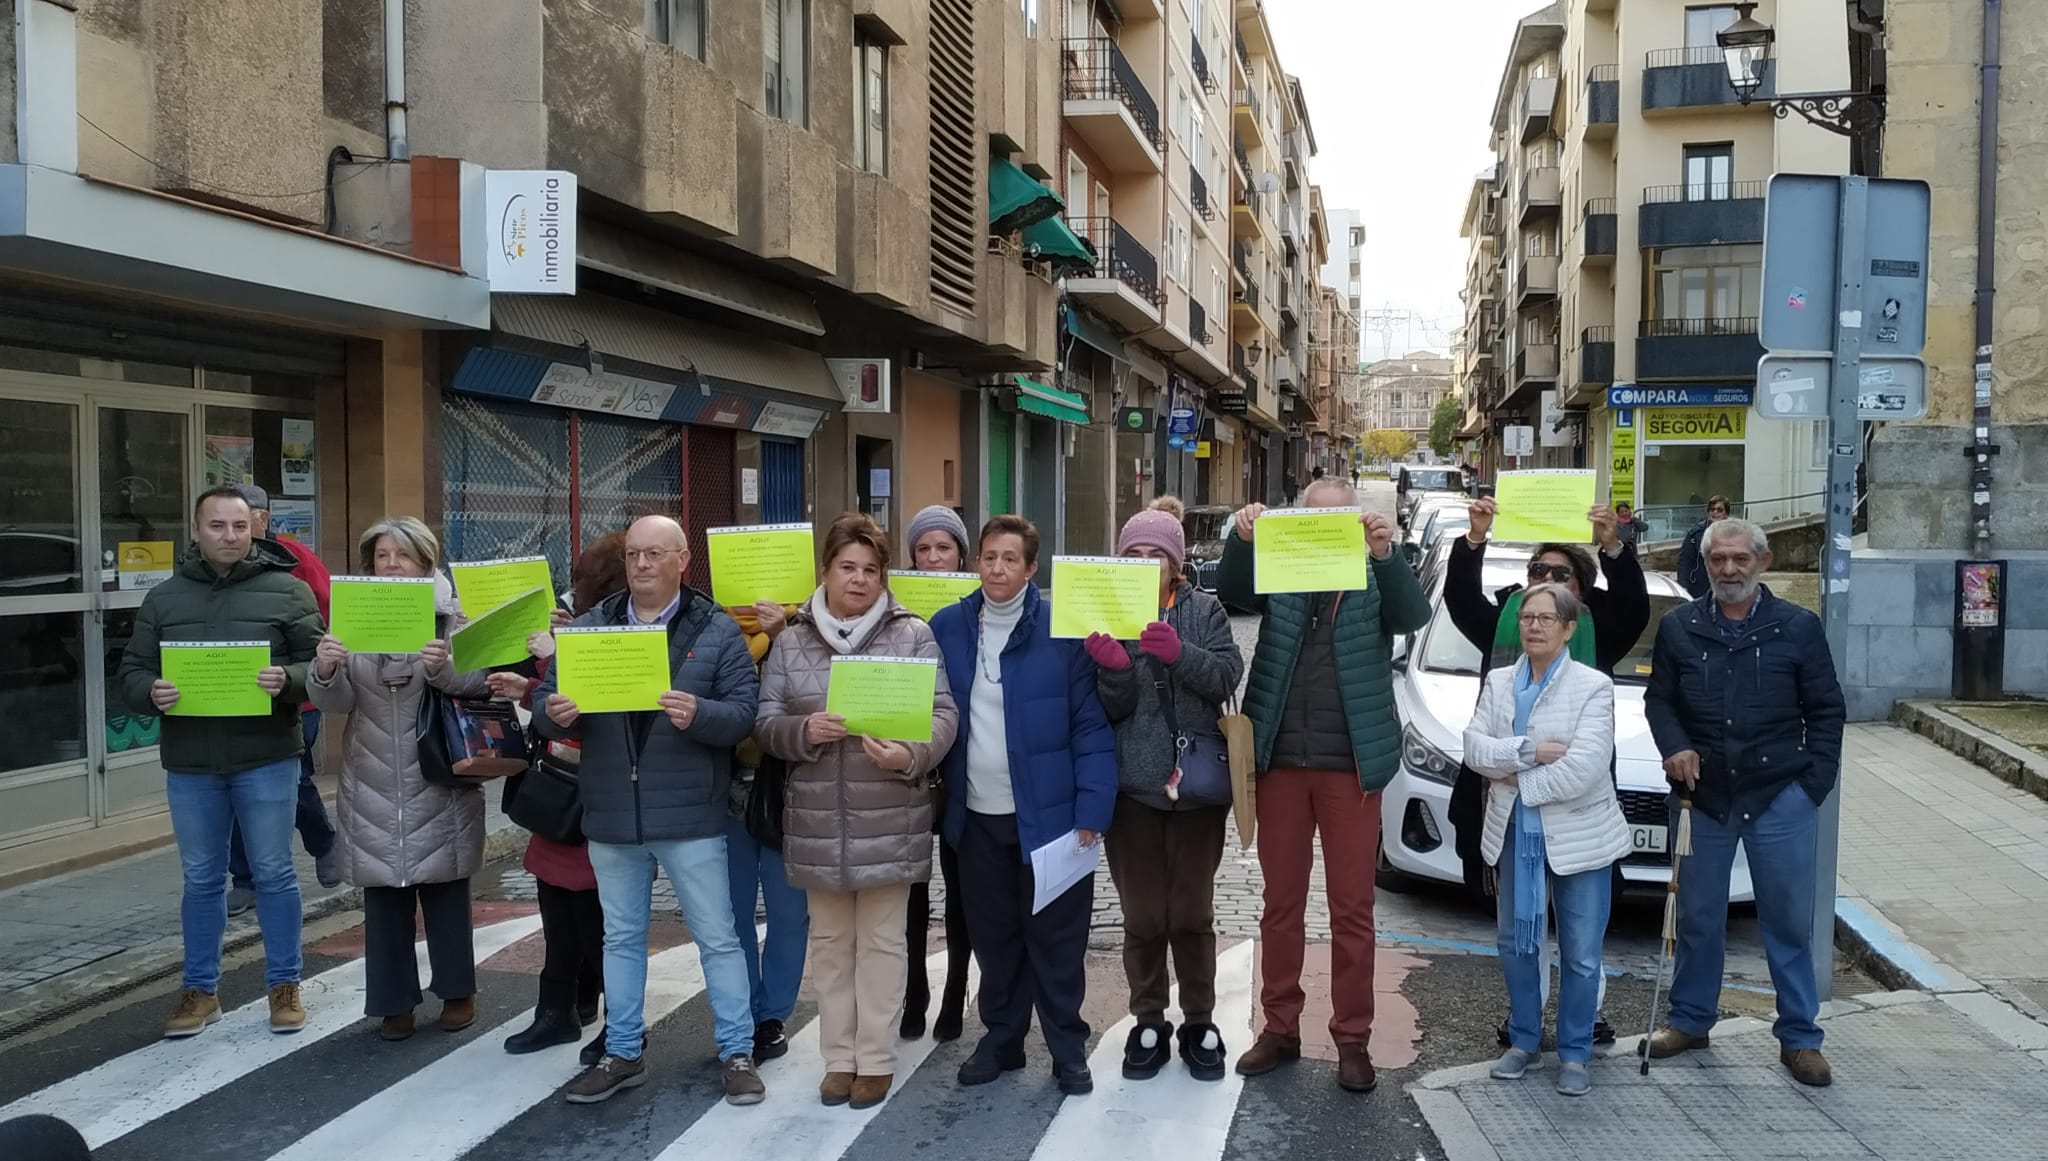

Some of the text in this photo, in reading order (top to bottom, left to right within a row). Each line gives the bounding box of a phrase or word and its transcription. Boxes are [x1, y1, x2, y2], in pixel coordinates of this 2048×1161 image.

[539, 178, 559, 282] inmobiliaria
[1611, 389, 1689, 404] COMPARA
[1713, 394, 1749, 403] SEGUROS
[1618, 410, 1631, 426] L
[1650, 413, 1733, 434] SEGOVIA
[1613, 456, 1635, 473] CAP
[629, 827, 661, 849] GL
